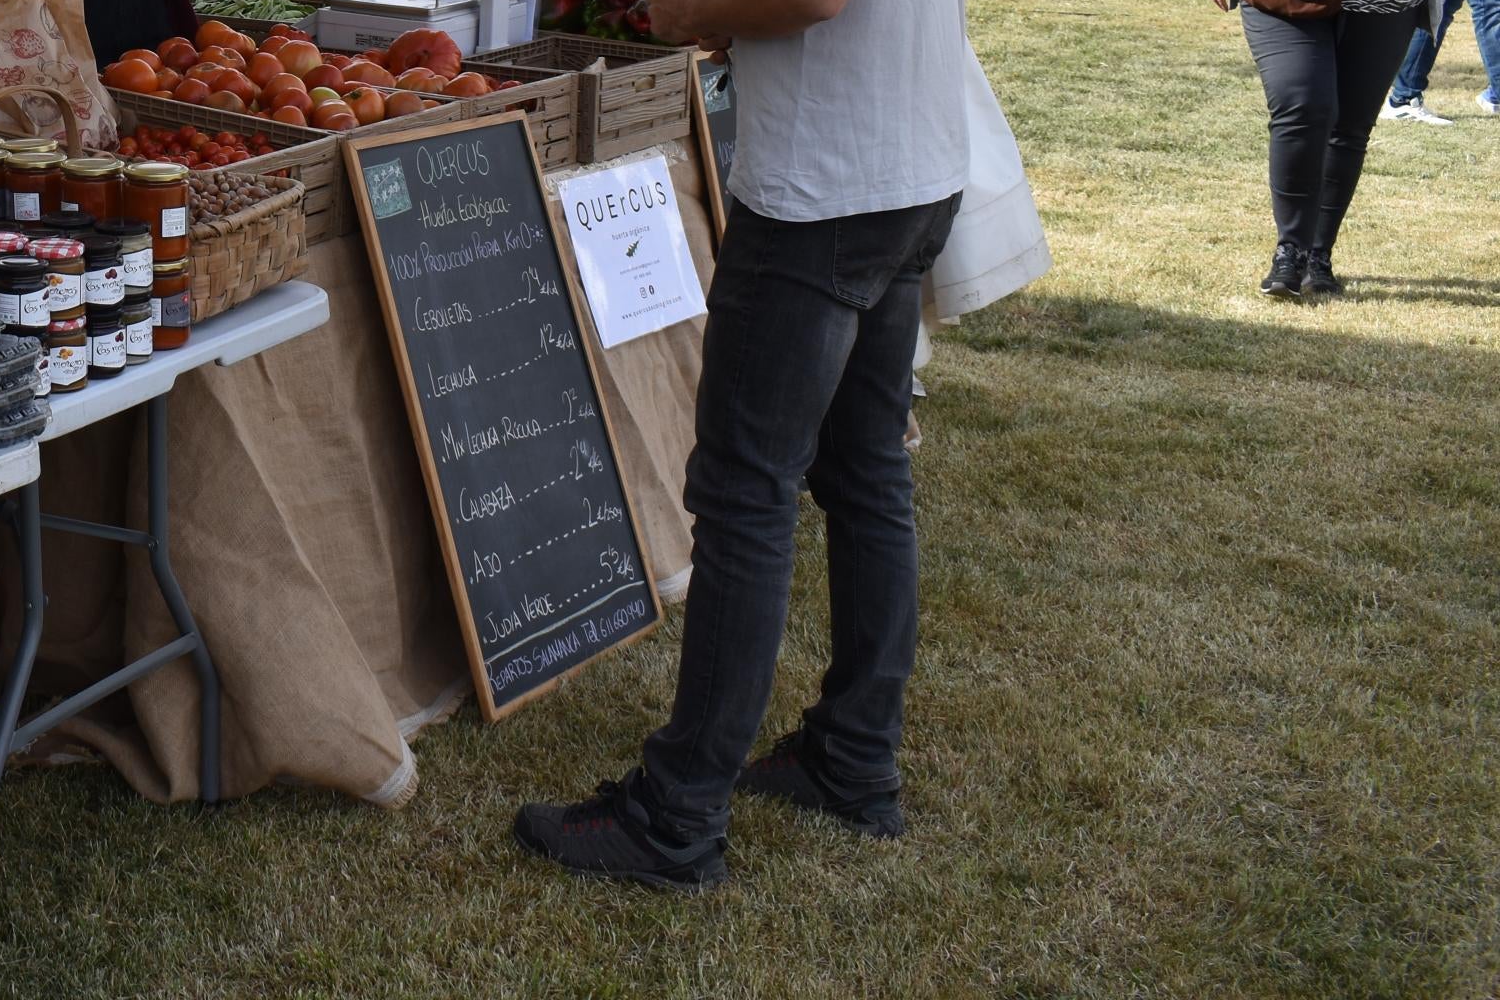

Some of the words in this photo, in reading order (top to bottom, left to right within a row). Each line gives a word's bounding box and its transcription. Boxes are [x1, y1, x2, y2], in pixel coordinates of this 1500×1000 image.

[416, 140, 490, 188] QUERCUS
[389, 251, 423, 281] 100%
[414, 297, 473, 332] CEBOLLETAS
[427, 363, 478, 398] LECHUGA
[459, 481, 516, 522] CALABAZA
[473, 550, 502, 583] AJO
[520, 592, 556, 622] VERDE
[485, 655, 533, 695] REPARTOS
